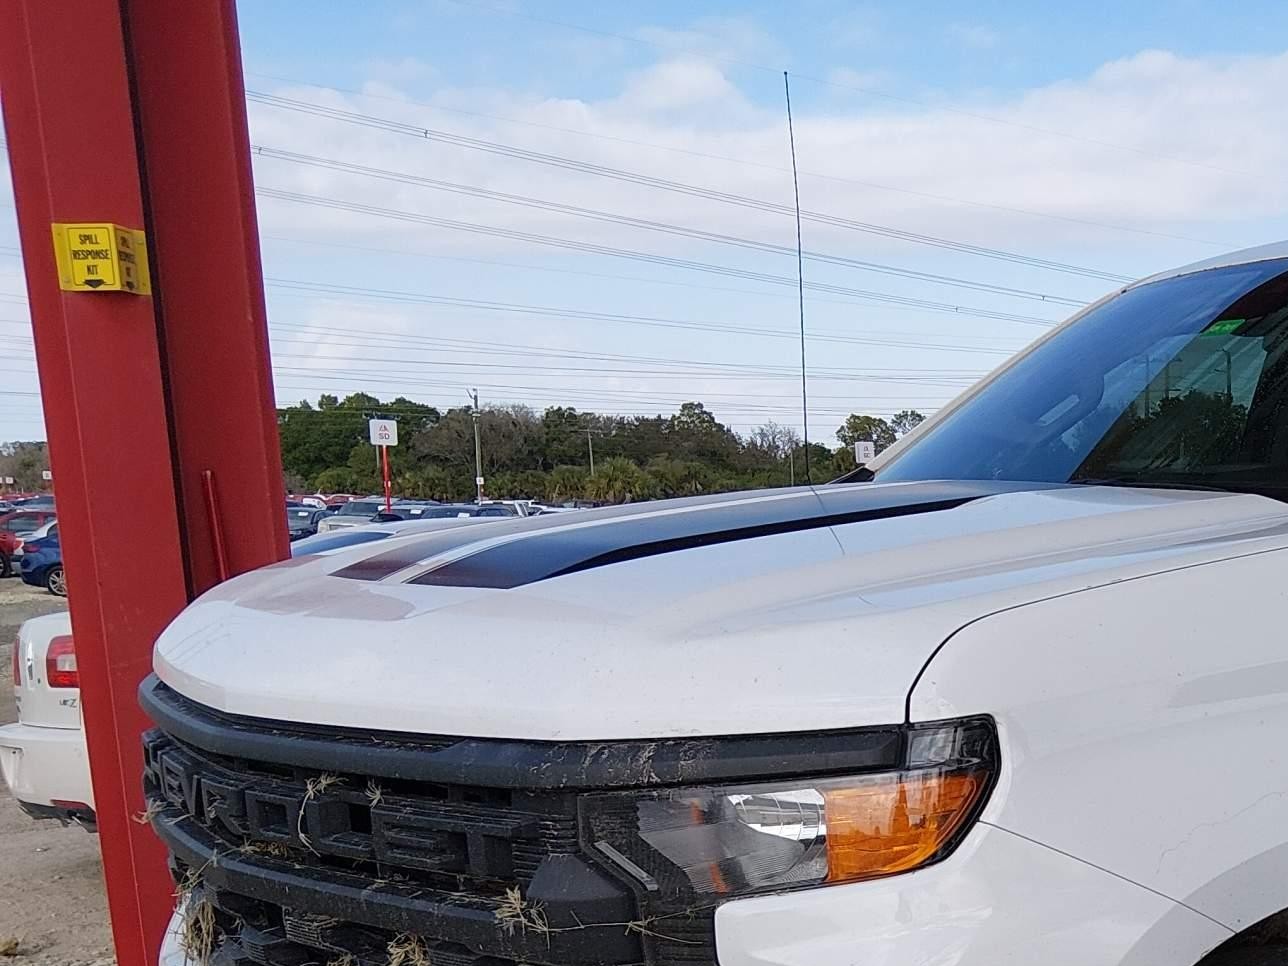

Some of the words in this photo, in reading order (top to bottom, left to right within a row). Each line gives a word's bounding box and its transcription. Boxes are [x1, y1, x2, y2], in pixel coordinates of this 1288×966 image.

[79, 234, 100, 245] SPILL
[72, 249, 111, 260] RESPONSE
[87, 264, 98, 275] KIT
